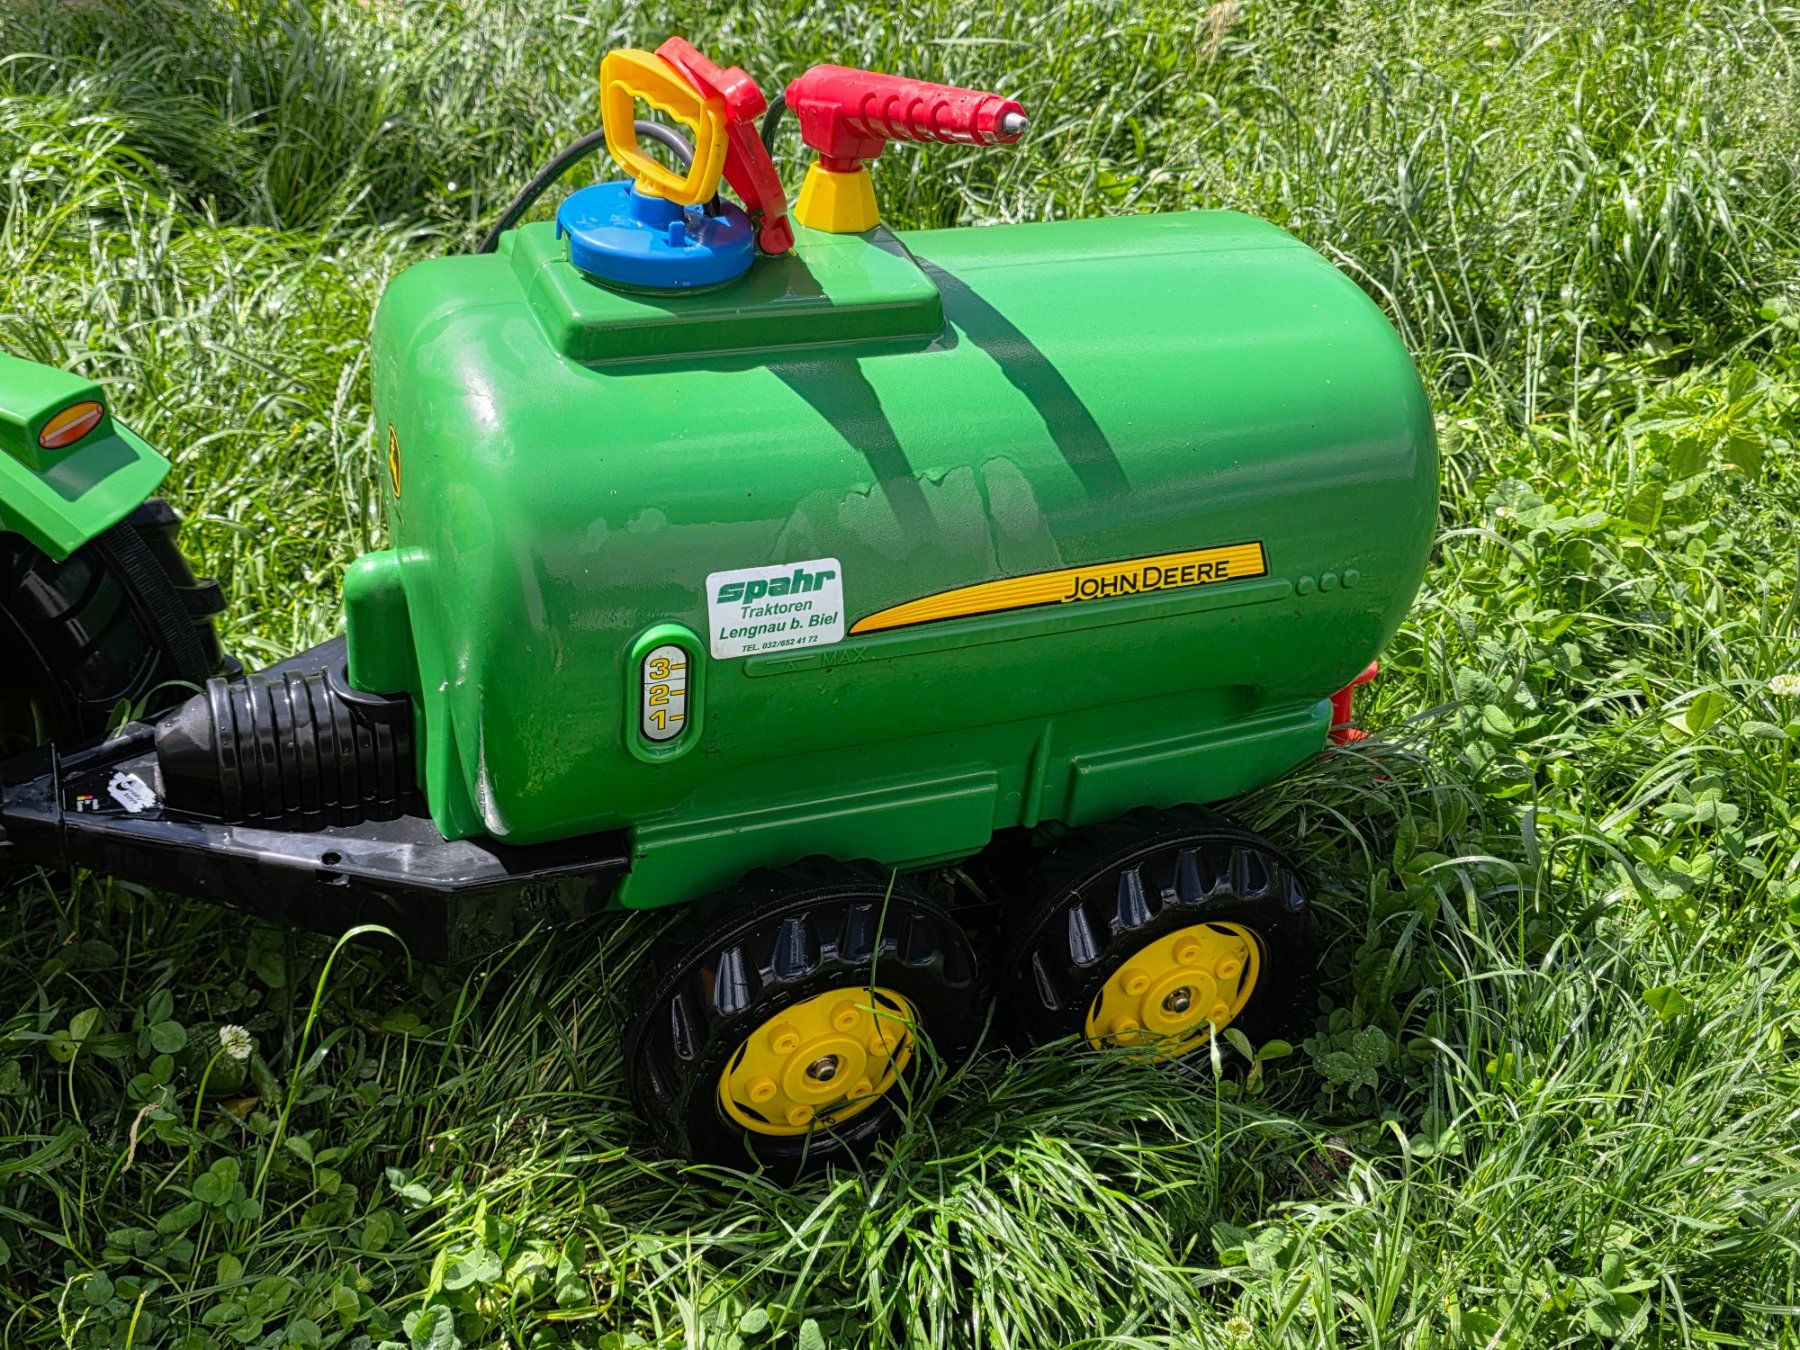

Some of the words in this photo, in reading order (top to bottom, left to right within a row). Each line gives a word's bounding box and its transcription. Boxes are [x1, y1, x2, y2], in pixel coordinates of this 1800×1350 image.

[716, 568, 836, 606] spahr
[1064, 573, 1138, 600] JOHN
[1141, 560, 1230, 588] DEERE
[741, 600, 813, 620] Traktoren
[719, 621, 787, 641] Lengnau
[789, 617, 804, 630] b.
[808, 611, 838, 627] Biel
[741, 643, 760, 653] TEL.
[761, 638, 795, 650] 032/652
[796, 636, 807, 645] 41
[808, 635, 819, 644] 72
